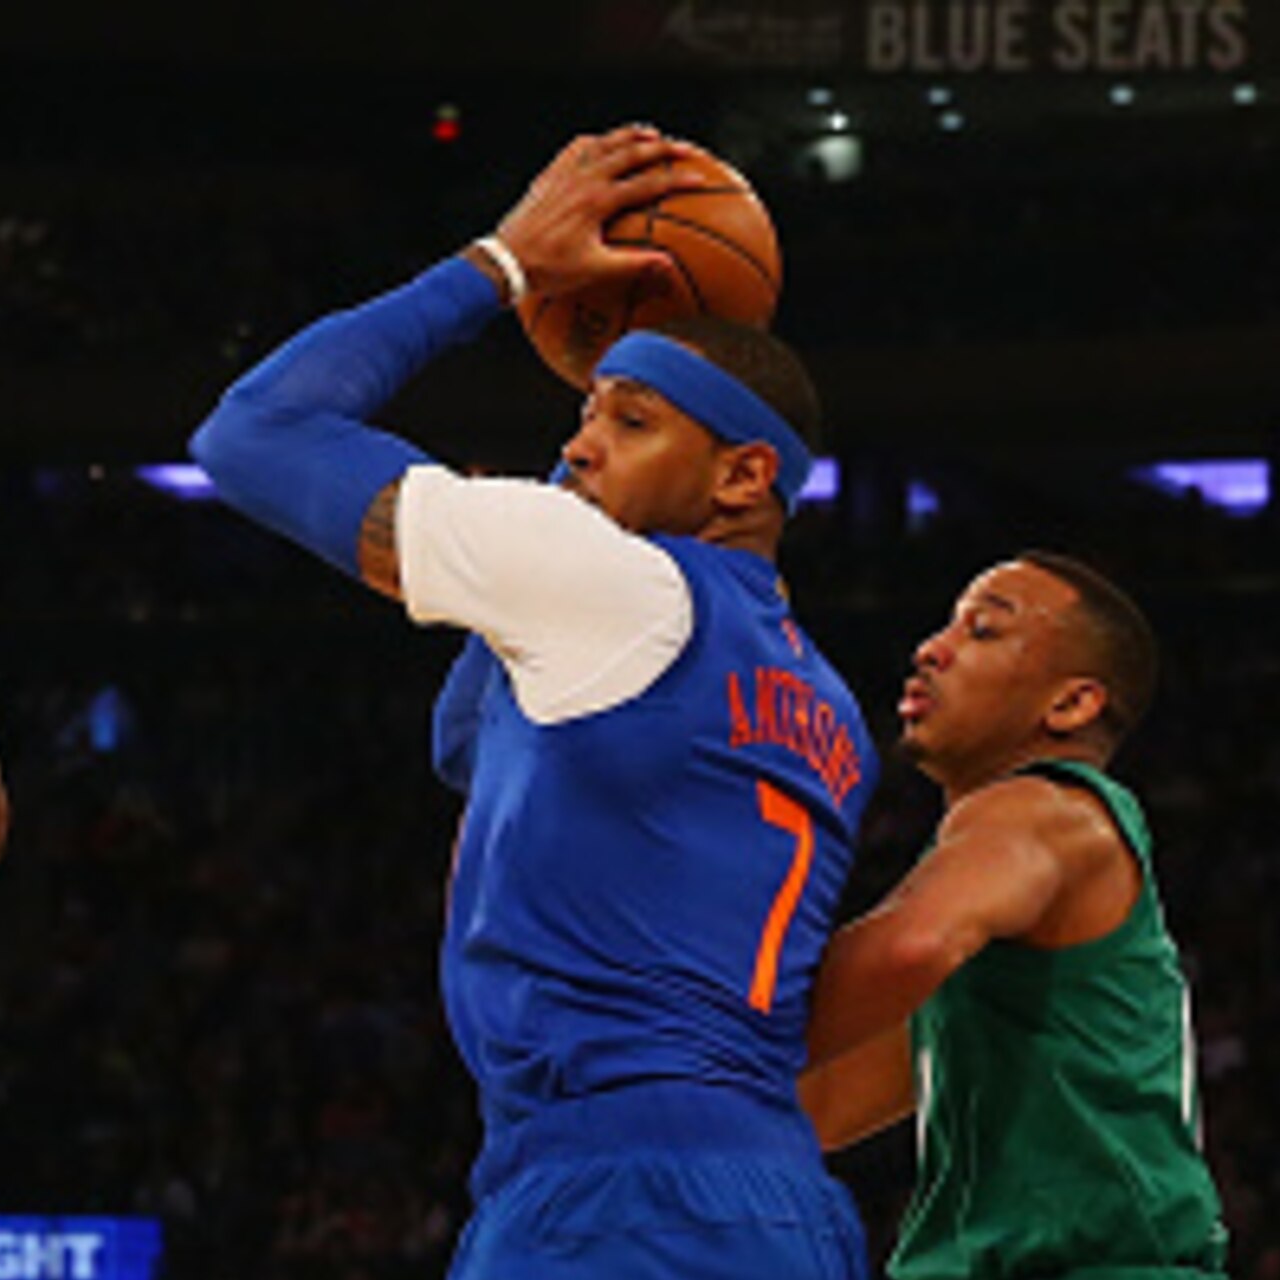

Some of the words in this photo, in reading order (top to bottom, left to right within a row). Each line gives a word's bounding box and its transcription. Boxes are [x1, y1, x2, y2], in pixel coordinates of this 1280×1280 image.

[865, 2, 1029, 71] BLUE
[1052, 2, 1249, 71] SEATS
[747, 778, 815, 1017] 7
